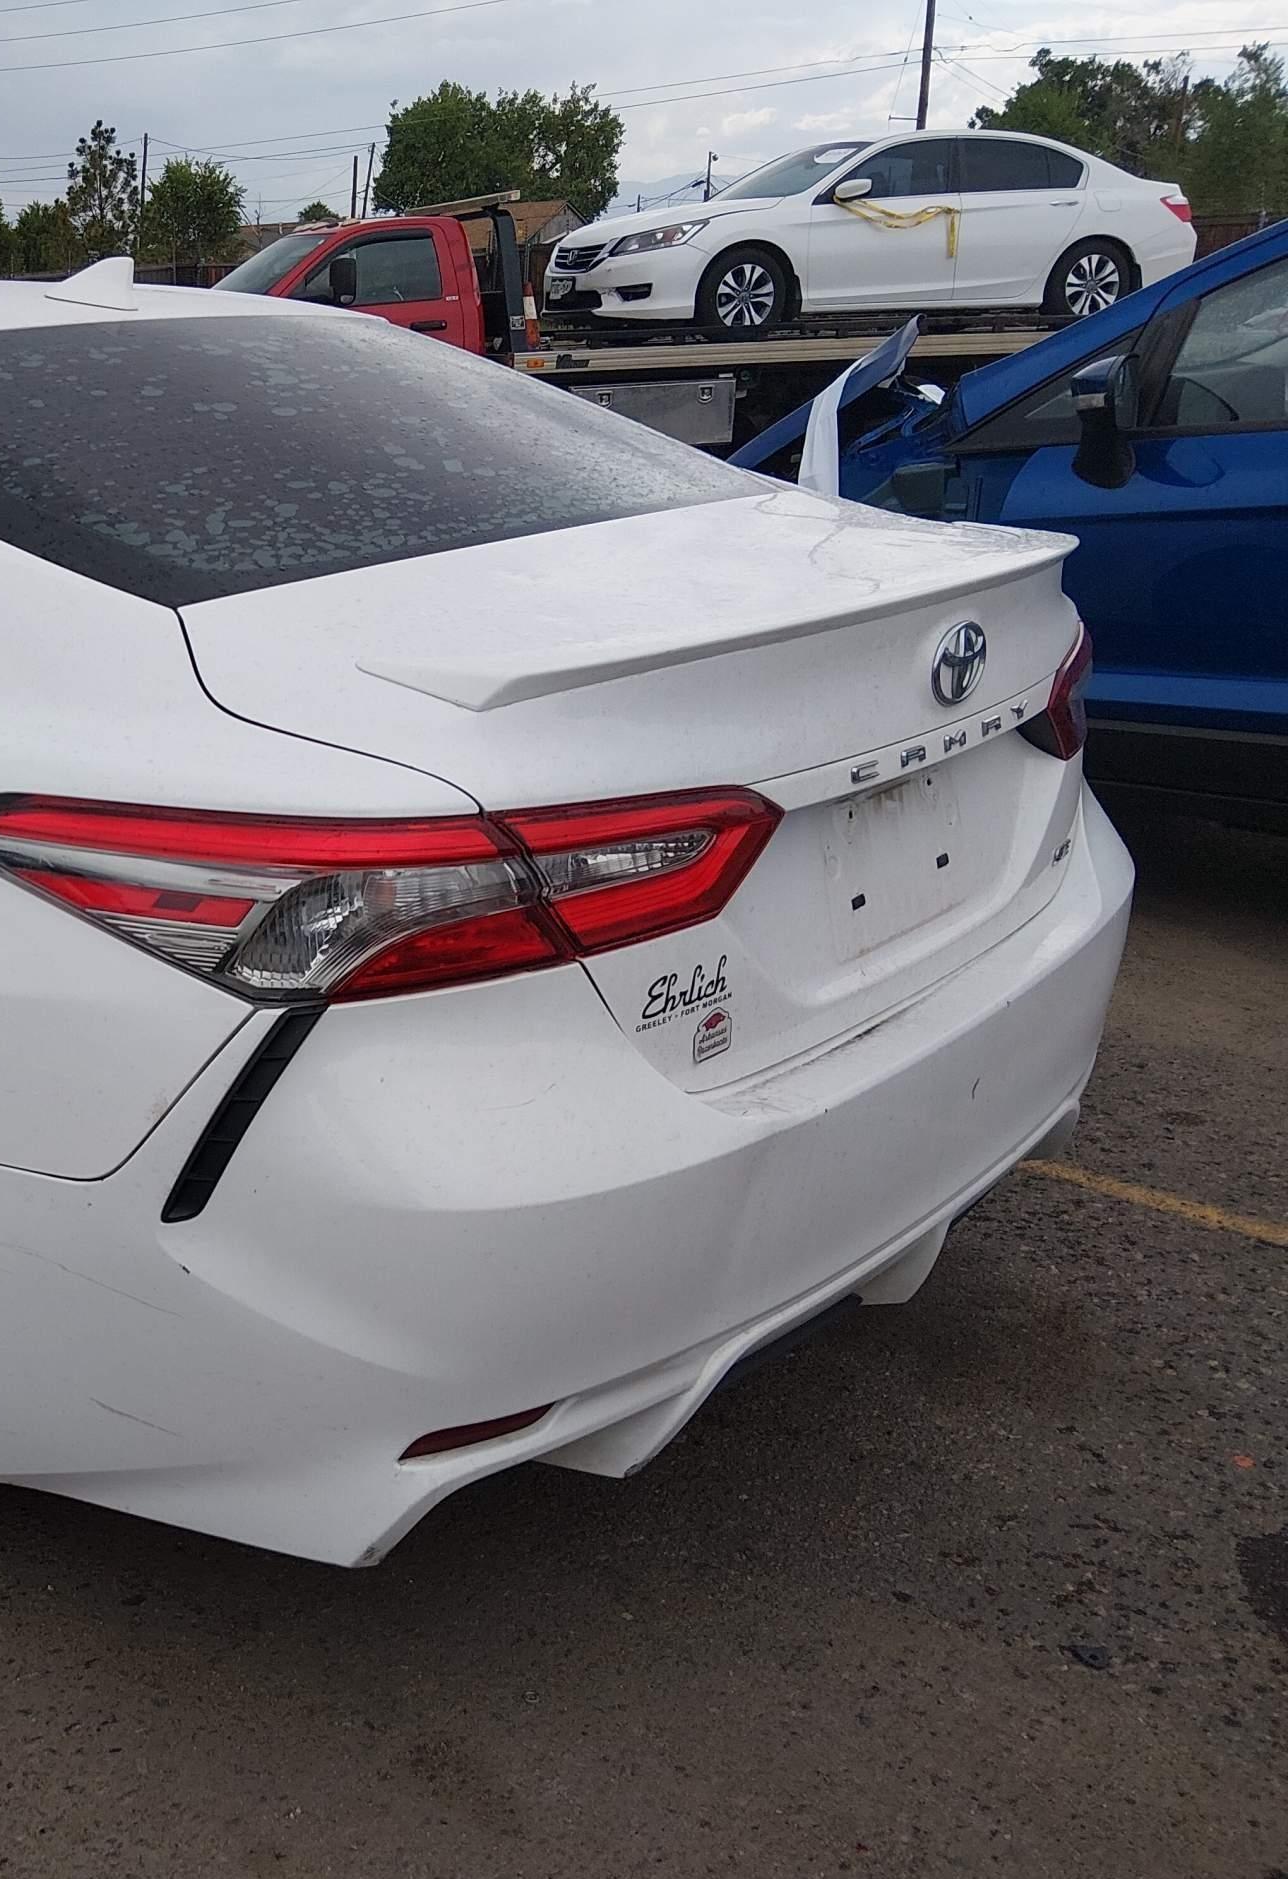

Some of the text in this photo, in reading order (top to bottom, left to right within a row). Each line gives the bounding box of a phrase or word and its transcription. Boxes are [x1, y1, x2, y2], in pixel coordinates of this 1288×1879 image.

[850, 700, 1028, 784] CAMRY
[635, 991, 732, 1033] GREELEY FORT MORGAN
[642, 954, 727, 1019] Ehrlich
